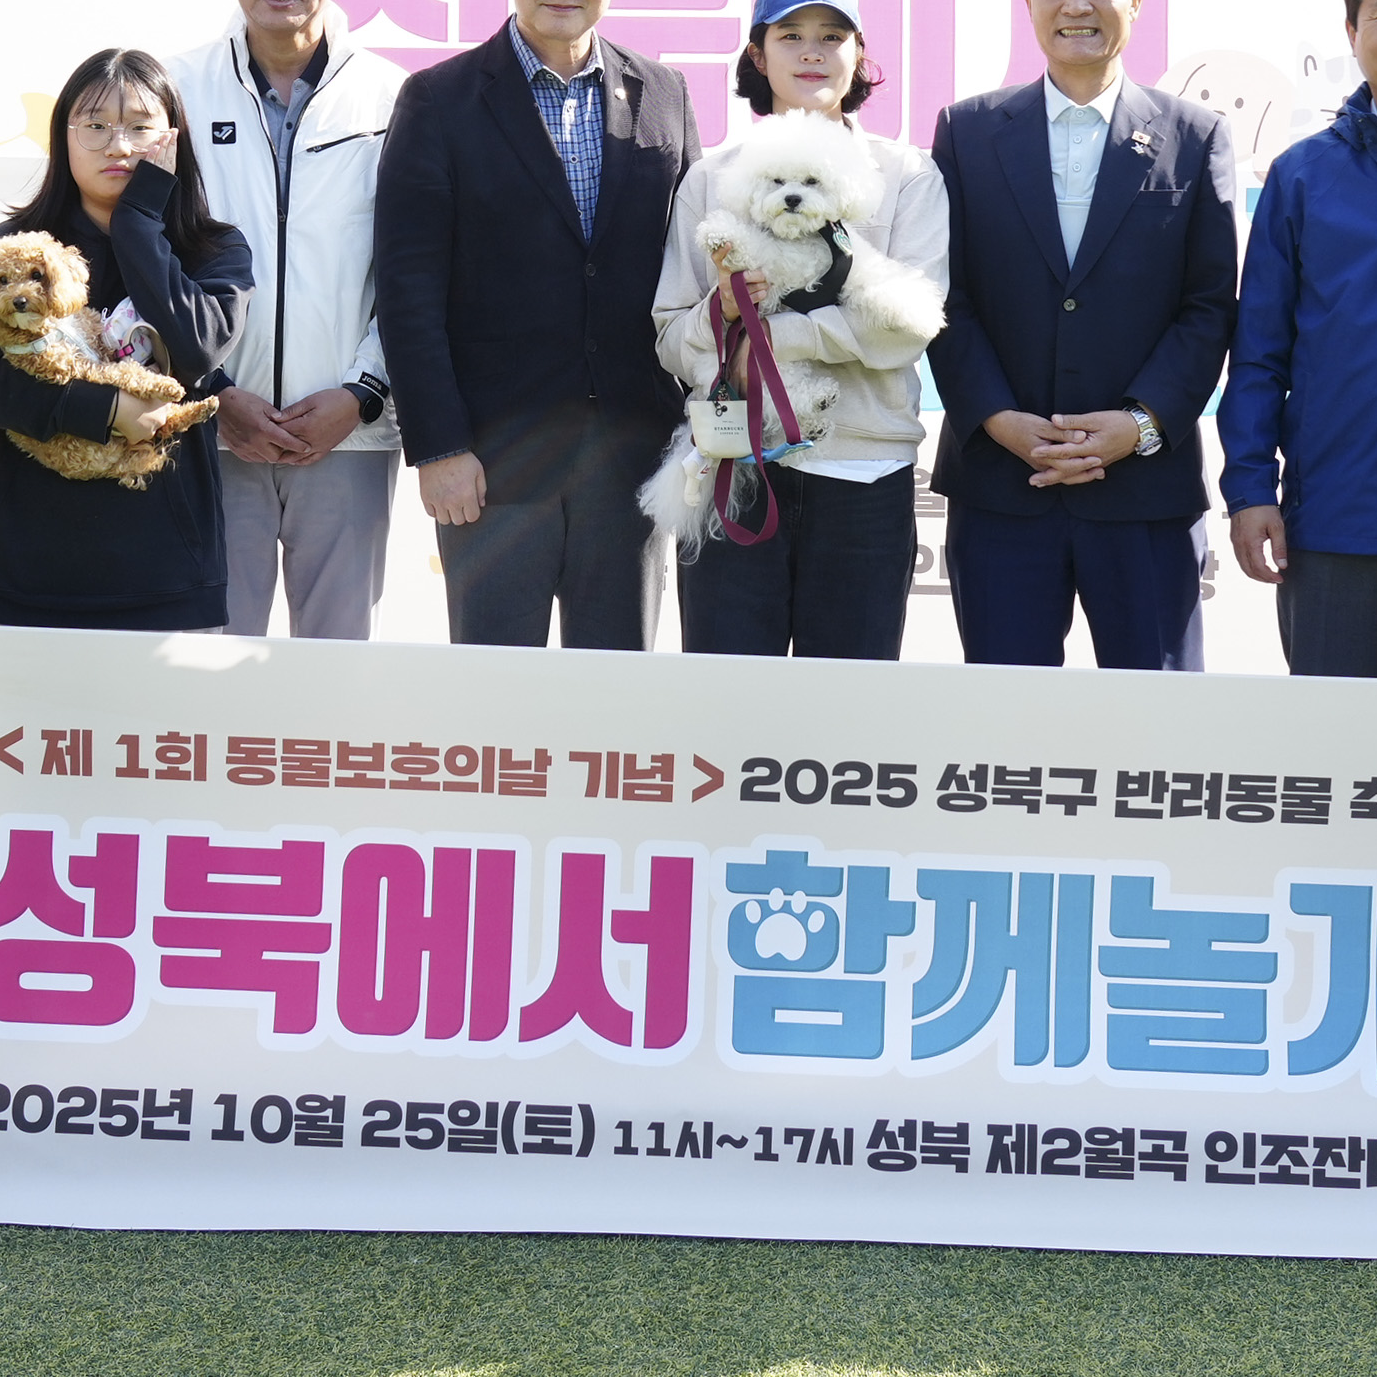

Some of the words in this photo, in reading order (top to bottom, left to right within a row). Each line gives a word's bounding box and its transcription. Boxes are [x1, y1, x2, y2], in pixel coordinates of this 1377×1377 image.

[39, 727, 93, 778] 제
[114, 729, 209, 783] 1회
[225, 735, 553, 798] 동물보호의날
[568, 750, 675, 803] 기념
[739, 756, 919, 809] 2025
[935, 763, 1098, 817] 성북구
[1114, 769, 1333, 826] 반려동물
[210, 1093, 347, 1149] 10월
[360, 1099, 596, 1158] 25일(토)
[613, 1117, 855, 1167] 11시~17시
[865, 1118, 971, 1174] 성북
[984, 1123, 1190, 1183] 제2월곡
